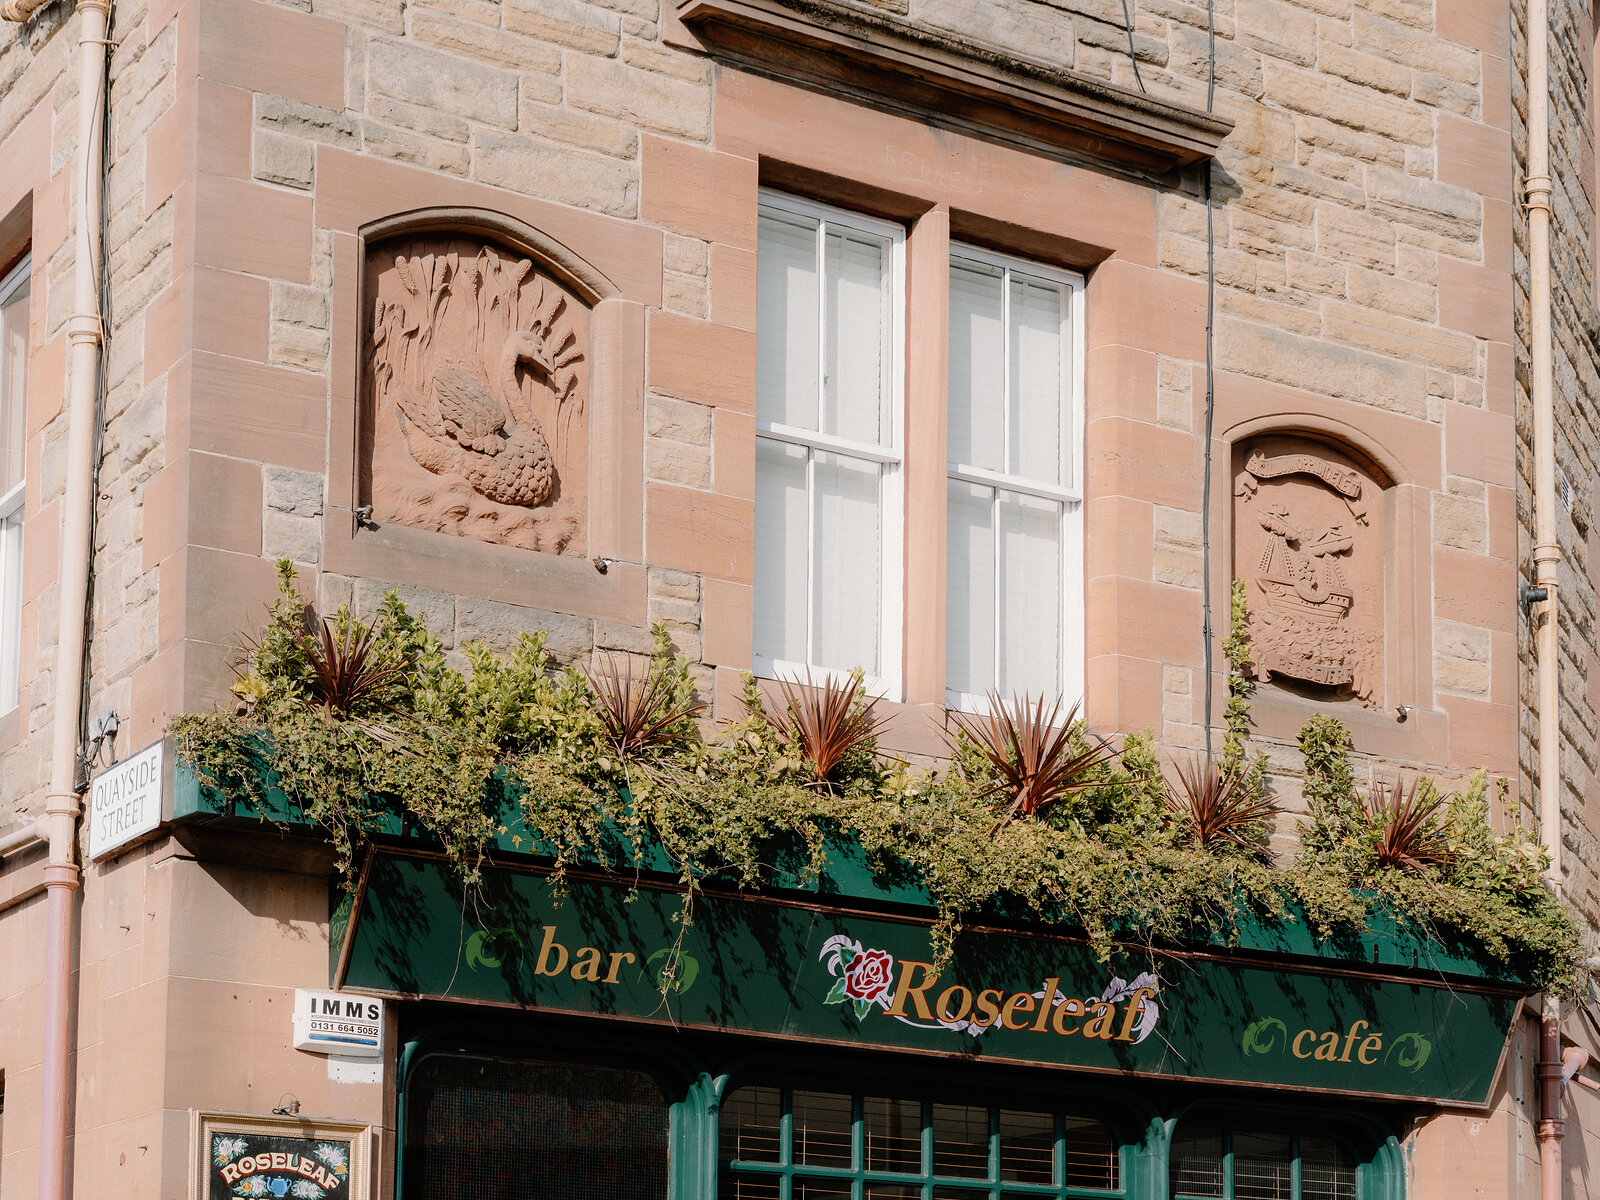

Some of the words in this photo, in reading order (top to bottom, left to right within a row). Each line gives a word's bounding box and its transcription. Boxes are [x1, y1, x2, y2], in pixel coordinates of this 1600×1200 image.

[95, 755, 157, 811] QUAYSIDE
[101, 794, 147, 841] STREET
[534, 925, 636, 984] bar
[882, 958, 1156, 1042] Roseleaf
[311, 1022, 334, 1030] 0131
[338, 1024, 355, 1032] 664
[357, 1027, 379, 1035] 5052
[220, 1152, 341, 1190] ROSELEAF
